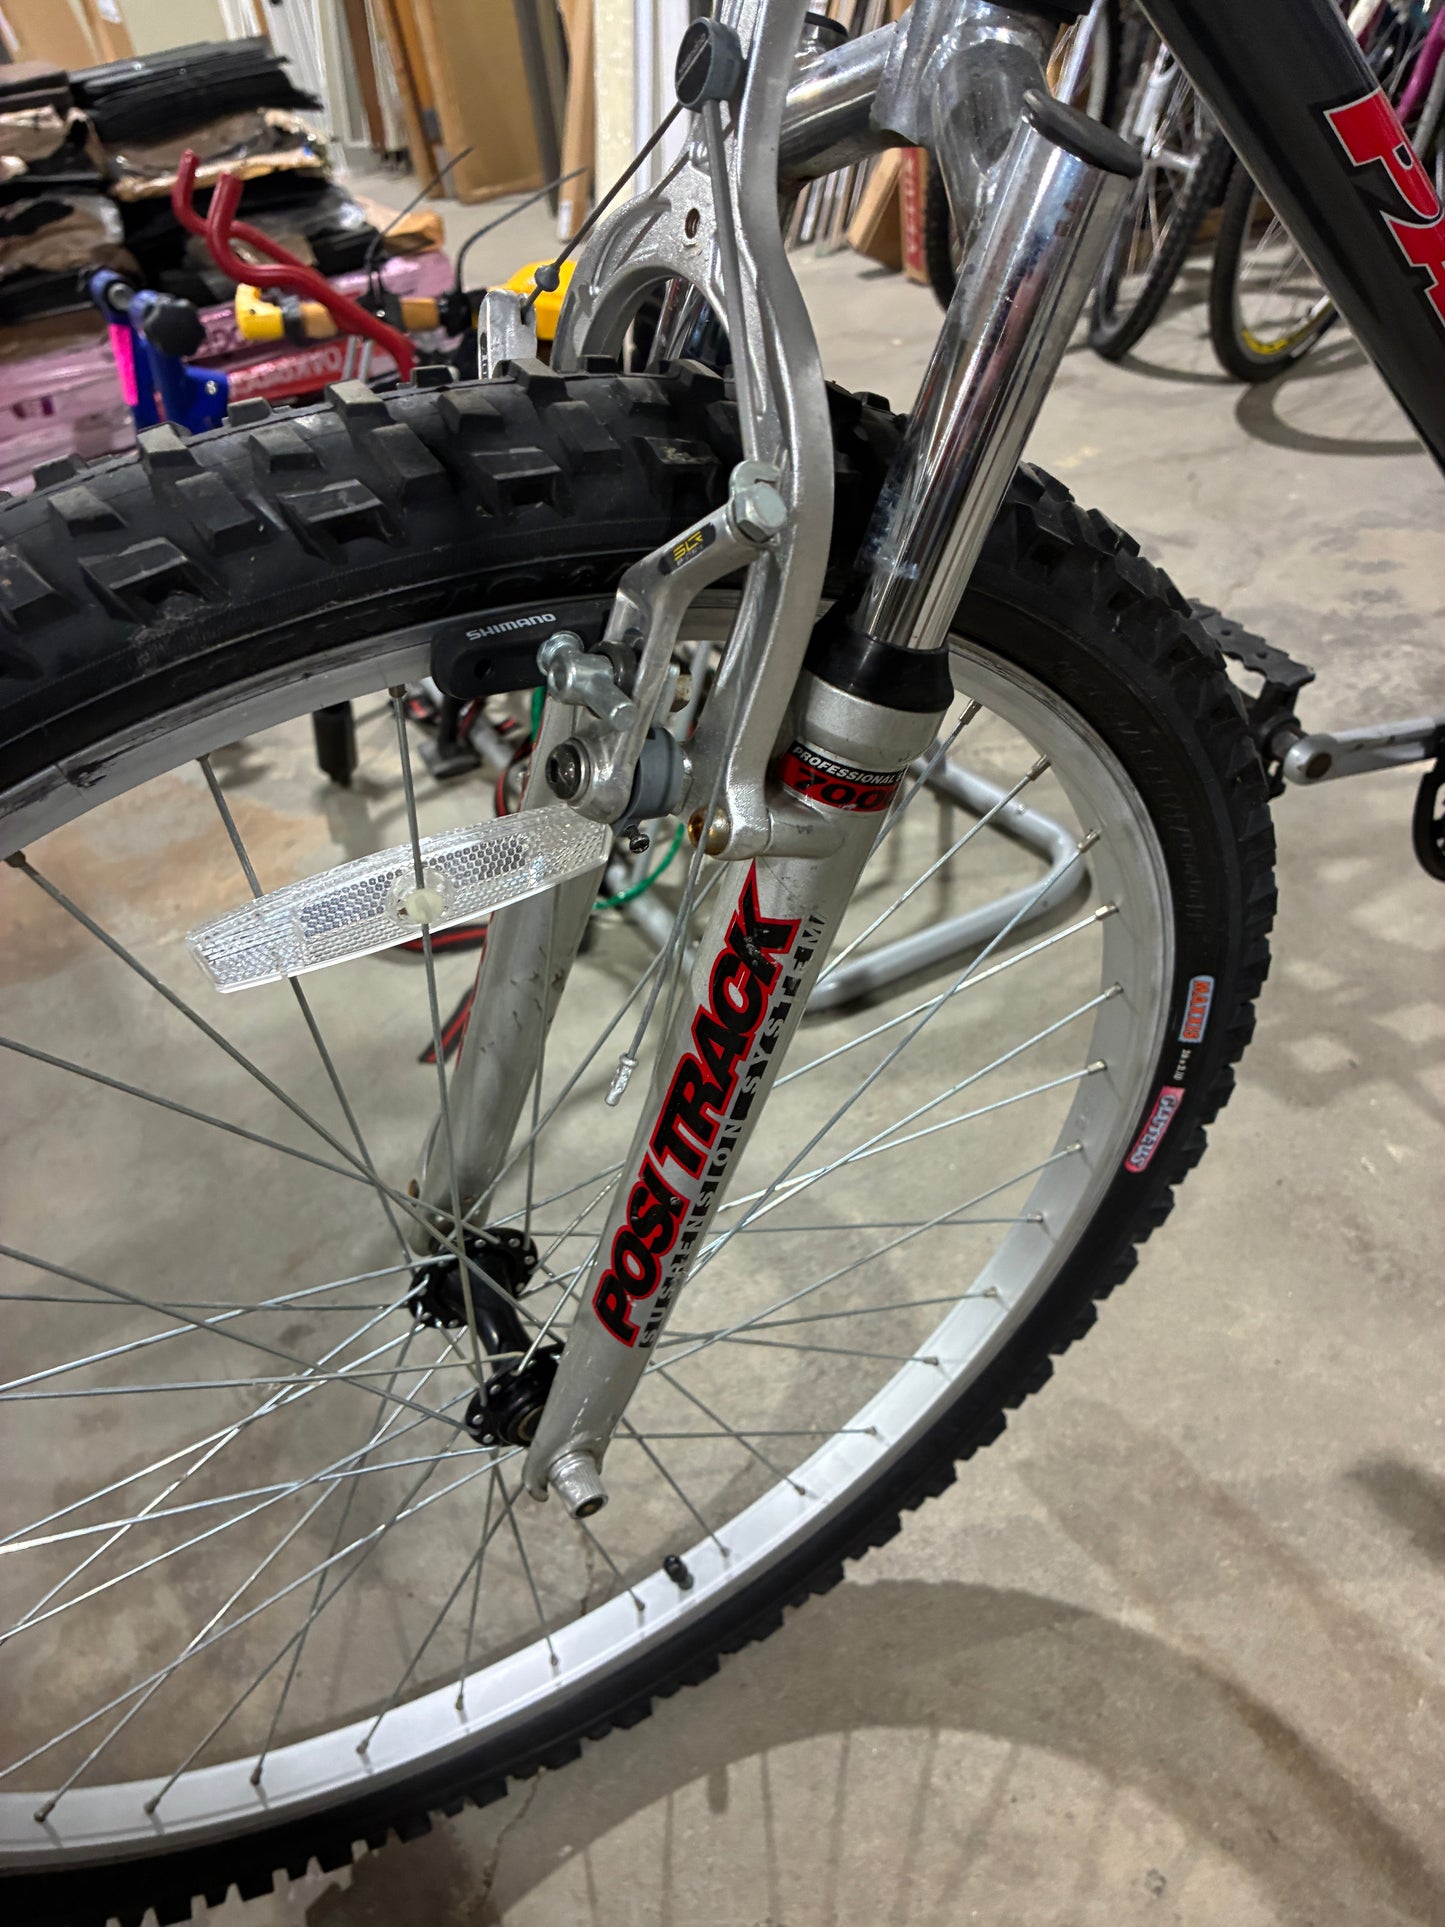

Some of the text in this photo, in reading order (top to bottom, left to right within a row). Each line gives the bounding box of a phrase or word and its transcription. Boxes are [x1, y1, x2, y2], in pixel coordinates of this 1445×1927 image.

[673, 530, 704, 561] SLR
[466, 613, 557, 640] SHIMANO
[792, 746, 894, 784] PROFESSIONAL
[1182, 980, 1211, 1039] MAXXIS
